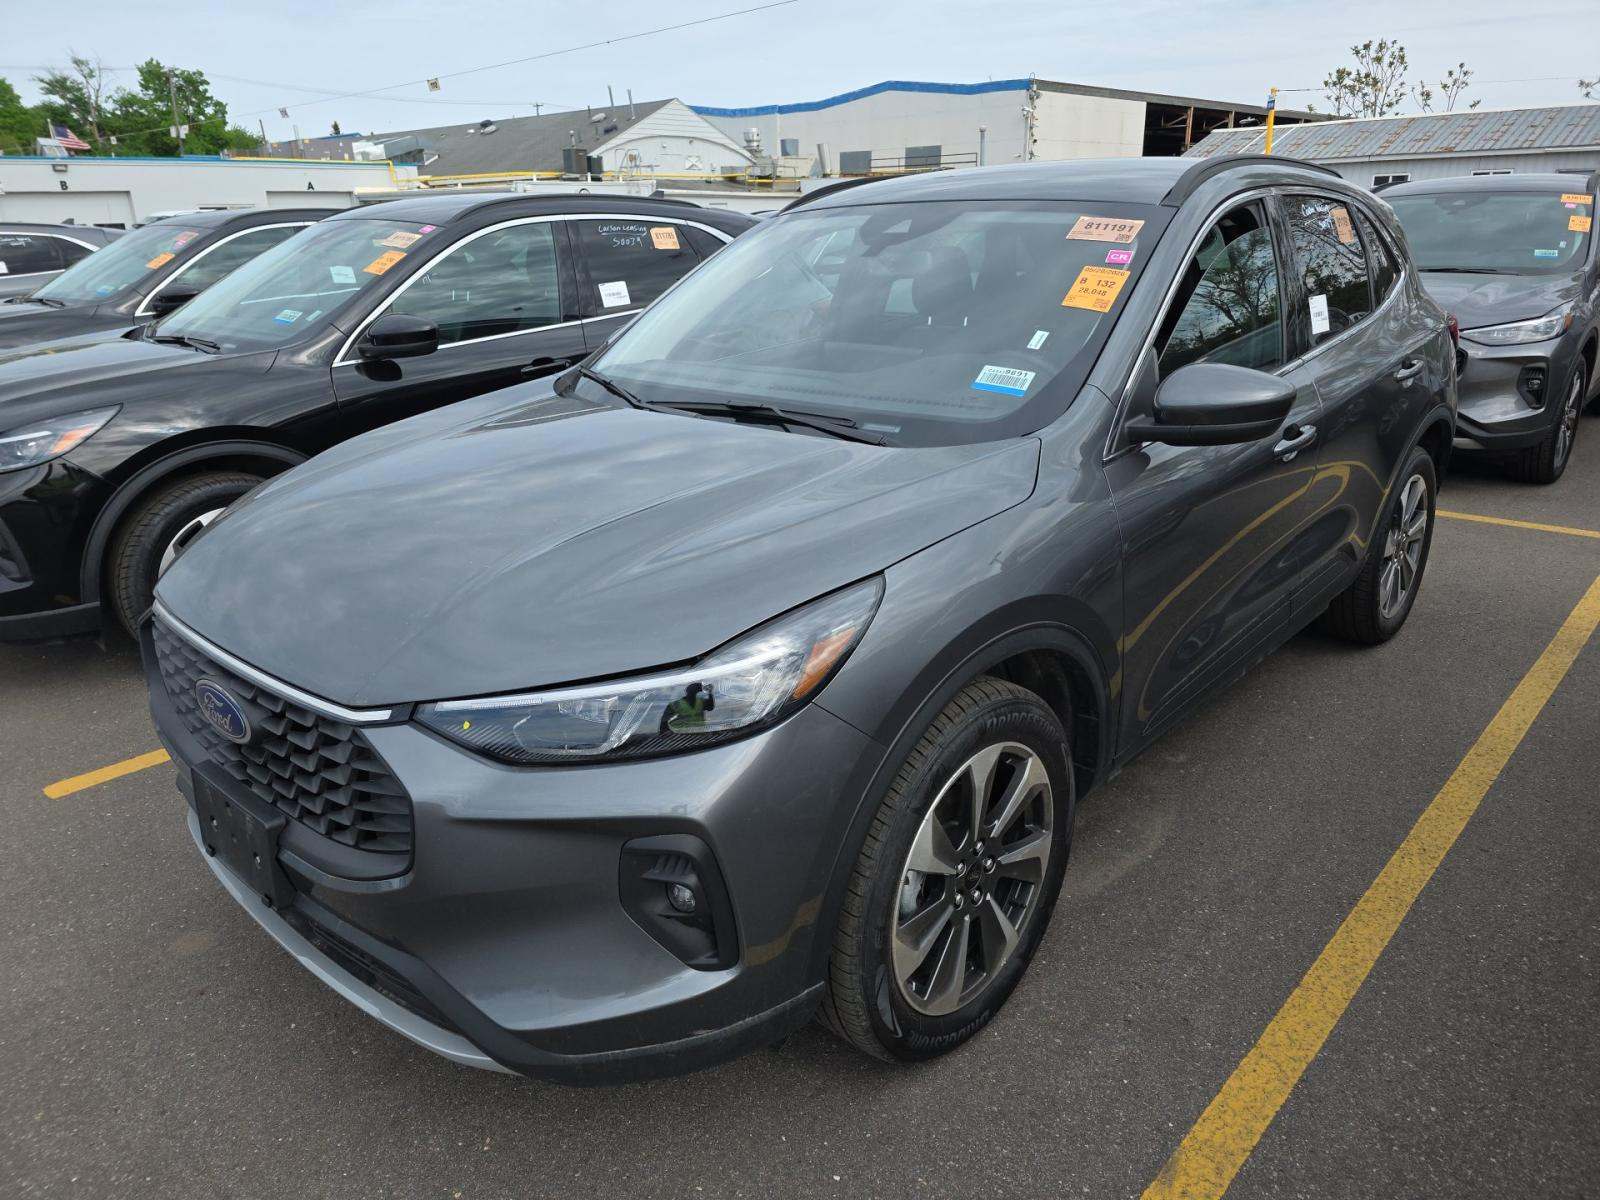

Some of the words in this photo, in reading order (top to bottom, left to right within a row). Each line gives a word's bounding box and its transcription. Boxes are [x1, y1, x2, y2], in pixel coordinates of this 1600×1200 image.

[60, 181, 69, 191] B
[306, 182, 315, 191] A
[1084, 221, 1134, 233] 811191
[1111, 253, 1128, 261] CR
[204, 691, 233, 732] Ford
